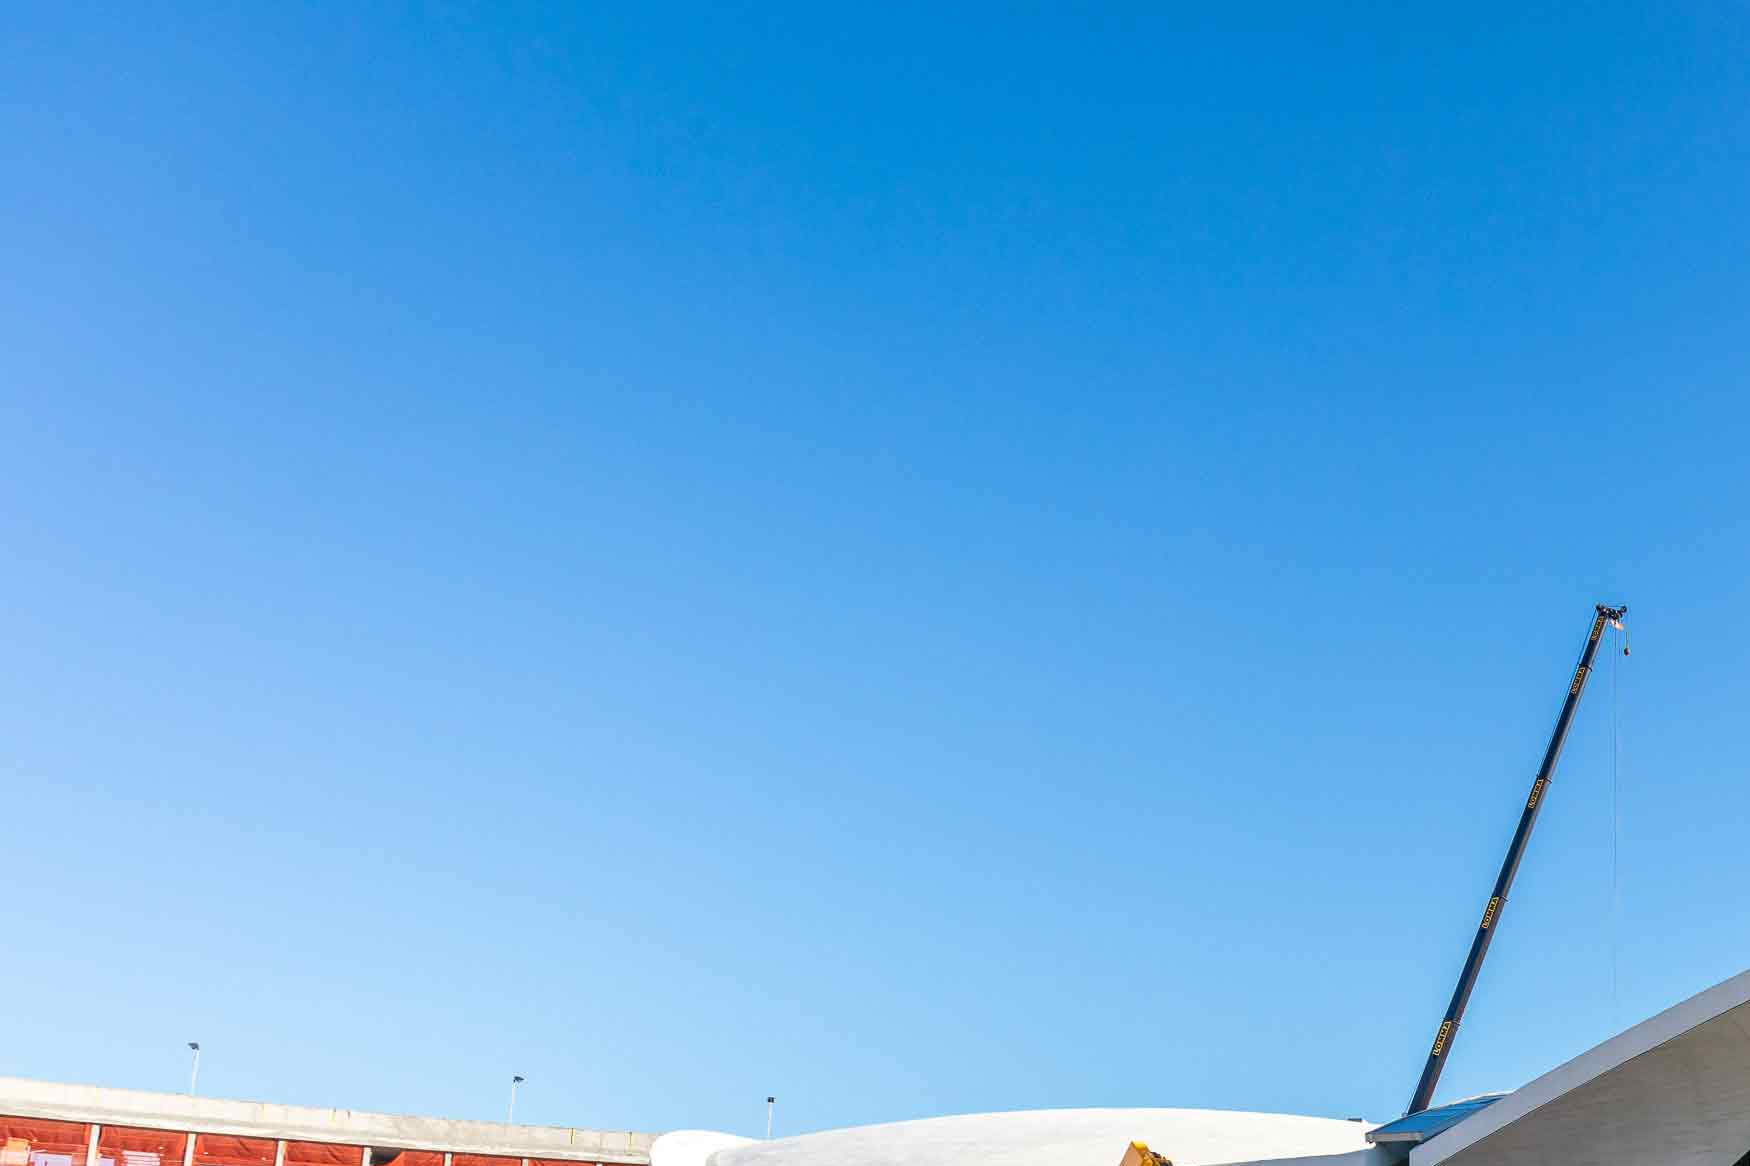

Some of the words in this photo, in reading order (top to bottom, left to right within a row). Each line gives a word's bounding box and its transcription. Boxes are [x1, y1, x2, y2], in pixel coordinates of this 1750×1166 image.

[1527, 779, 1544, 809] LOMMA
[1481, 896, 1499, 929] LOMMA
[1432, 1021, 1452, 1056] LOMMA
